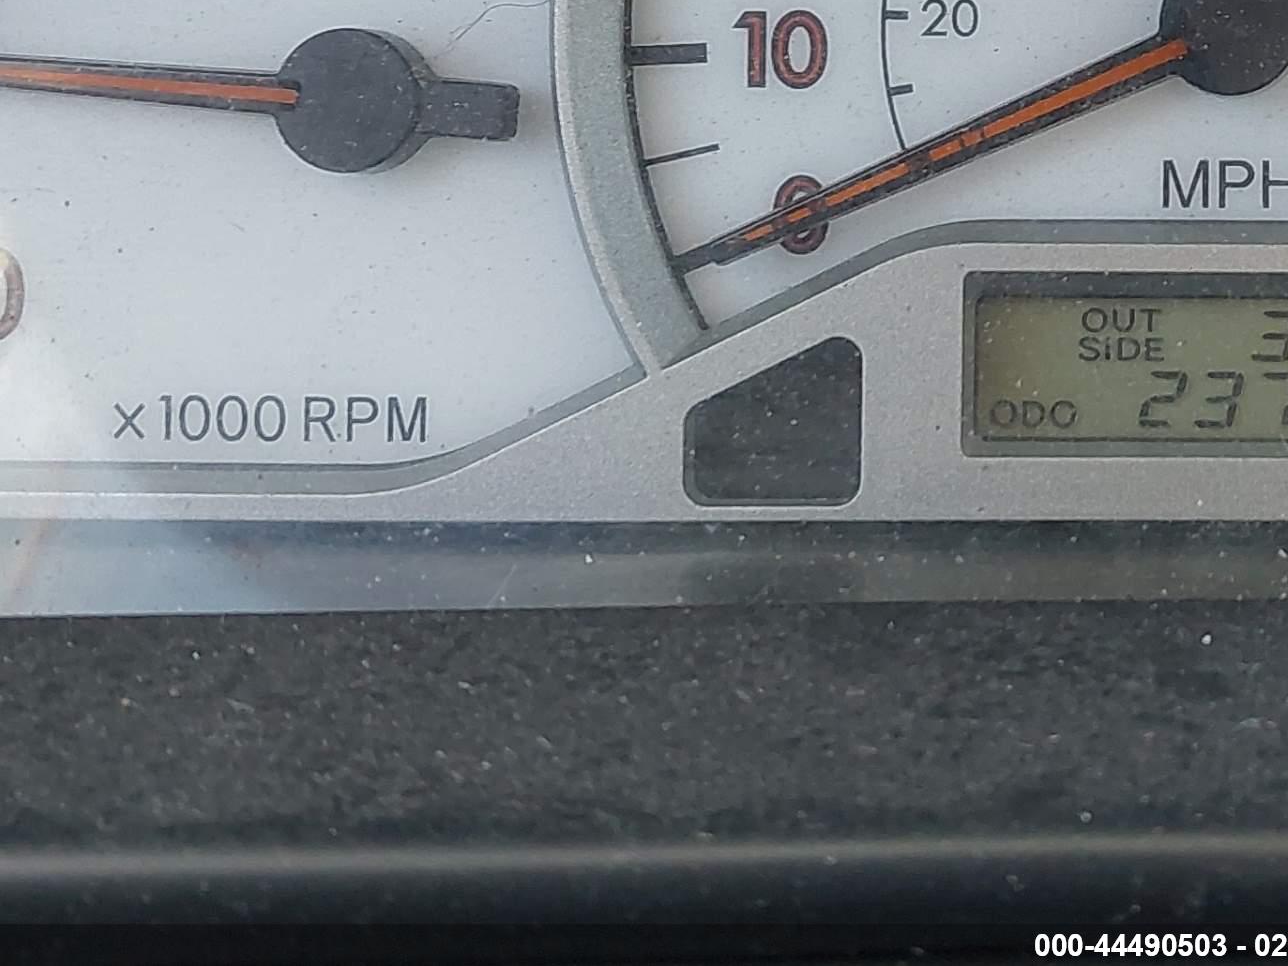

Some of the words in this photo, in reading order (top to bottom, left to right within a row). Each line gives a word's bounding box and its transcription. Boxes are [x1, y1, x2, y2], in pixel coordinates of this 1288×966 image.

[922, 0, 979, 36] 20
[733, 11, 827, 89] 10
[1081, 307, 1163, 333] OUT
[303, 395, 427, 442] RPM
[990, 400, 1077, 428] ODO
